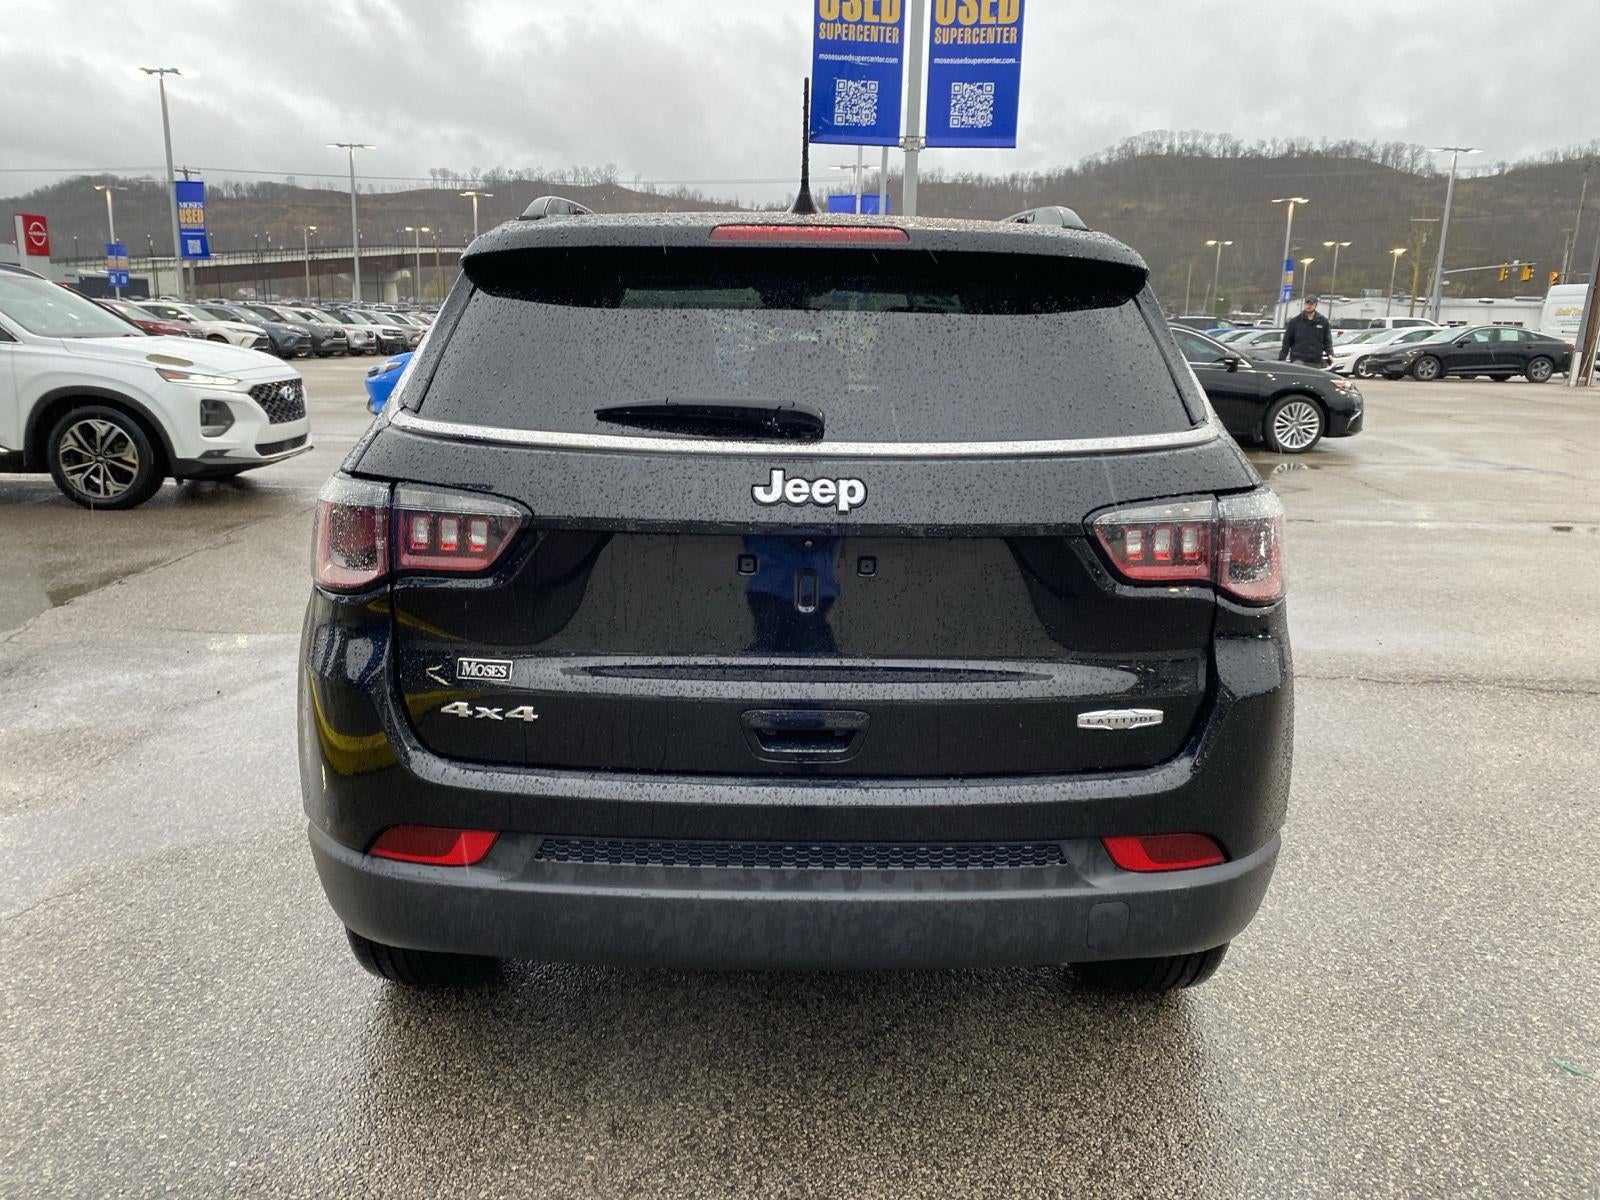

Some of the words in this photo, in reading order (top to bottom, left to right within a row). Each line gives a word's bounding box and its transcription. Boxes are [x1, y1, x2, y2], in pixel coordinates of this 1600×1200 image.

[818, 22, 899, 44] SUPERCENTER
[934, 26, 1018, 45] SUPERCENTER
[818, 53, 899, 64] mosesusedsupercenter.com
[934, 57, 1016, 66] mosesusedsupercenter.com
[178, 208, 204, 224] USED
[752, 469, 866, 512] Jeep
[461, 661, 508, 678] MOSES
[440, 701, 539, 722] 4x4
